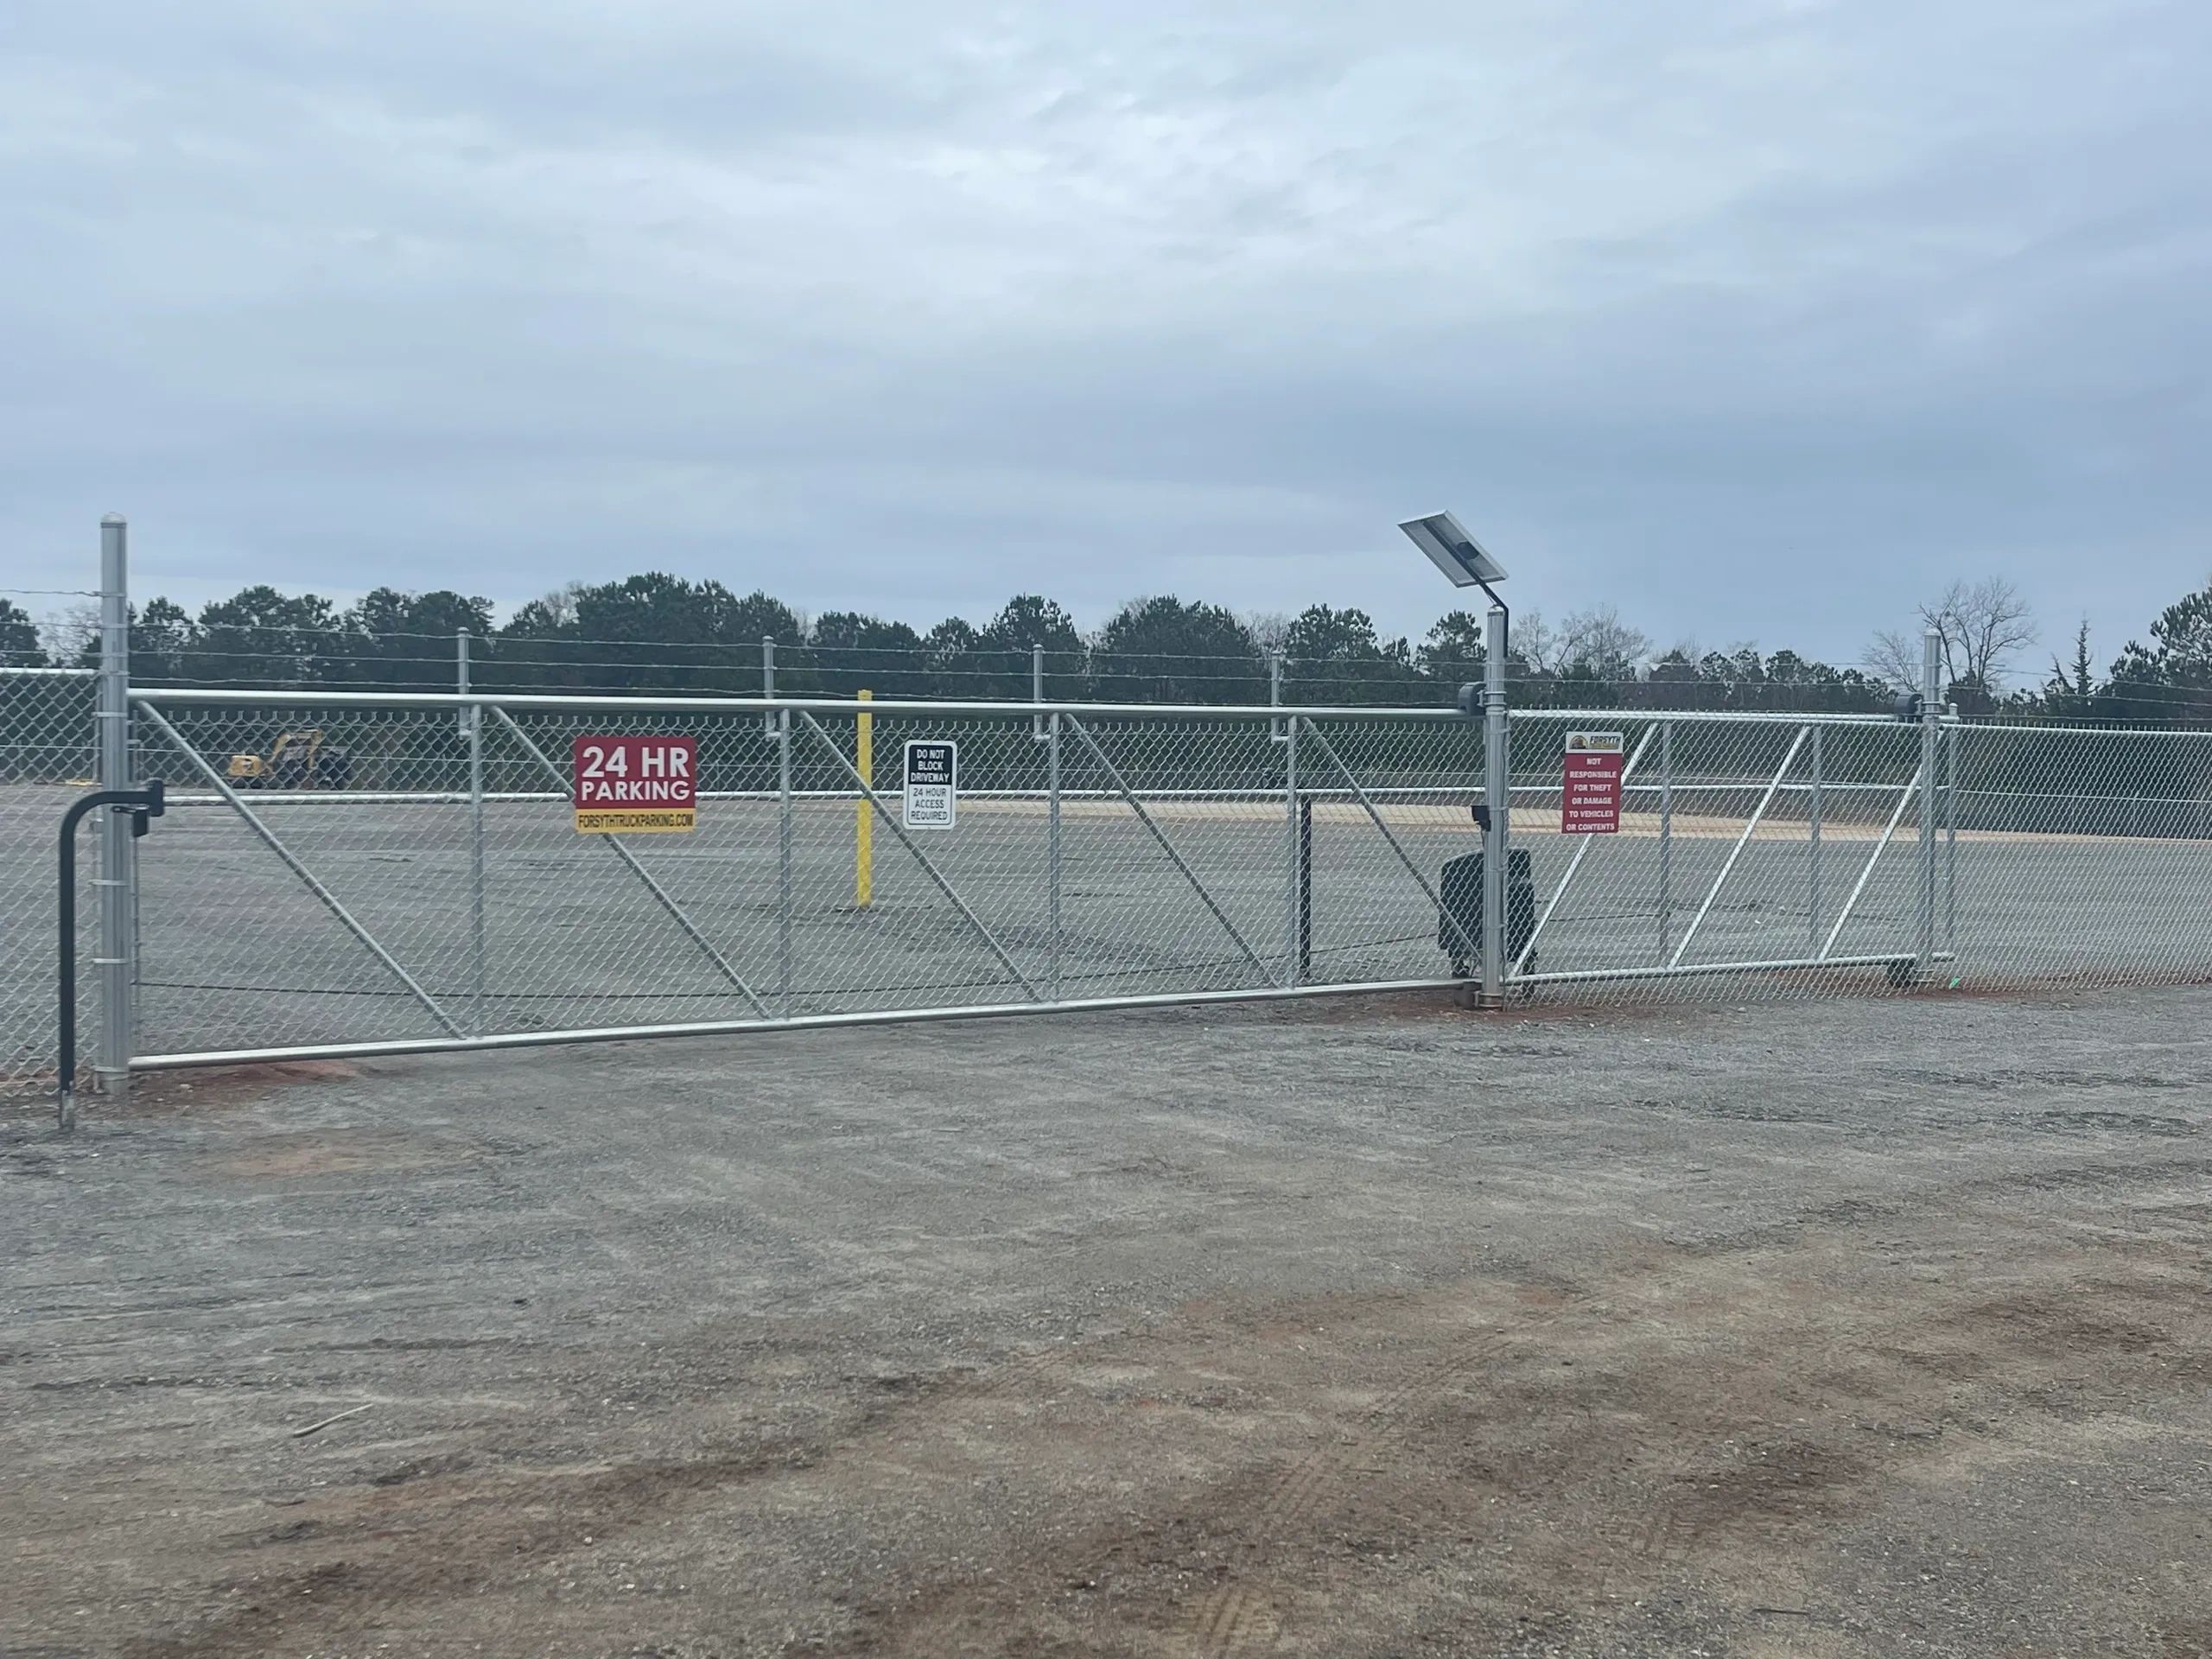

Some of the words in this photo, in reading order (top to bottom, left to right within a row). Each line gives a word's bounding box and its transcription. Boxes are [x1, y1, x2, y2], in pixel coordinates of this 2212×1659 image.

[916, 748, 928, 760] DO
[929, 749, 945, 760] NOT
[582, 746, 628, 778] 24
[642, 747, 690, 778] HR
[918, 760, 944, 771] BLOCK
[910, 772, 950, 783] DRIVEWAY
[582, 780, 690, 801] PARKING
[912, 787, 924, 797] 24
[925, 787, 947, 797] HOUR
[914, 799, 944, 809] ACCESS
[910, 810, 948, 821] REQUIRED
[578, 814, 694, 829] FORSYTHTRUCKPARKING.COM
[1578, 823, 1615, 831] CONTENTS
